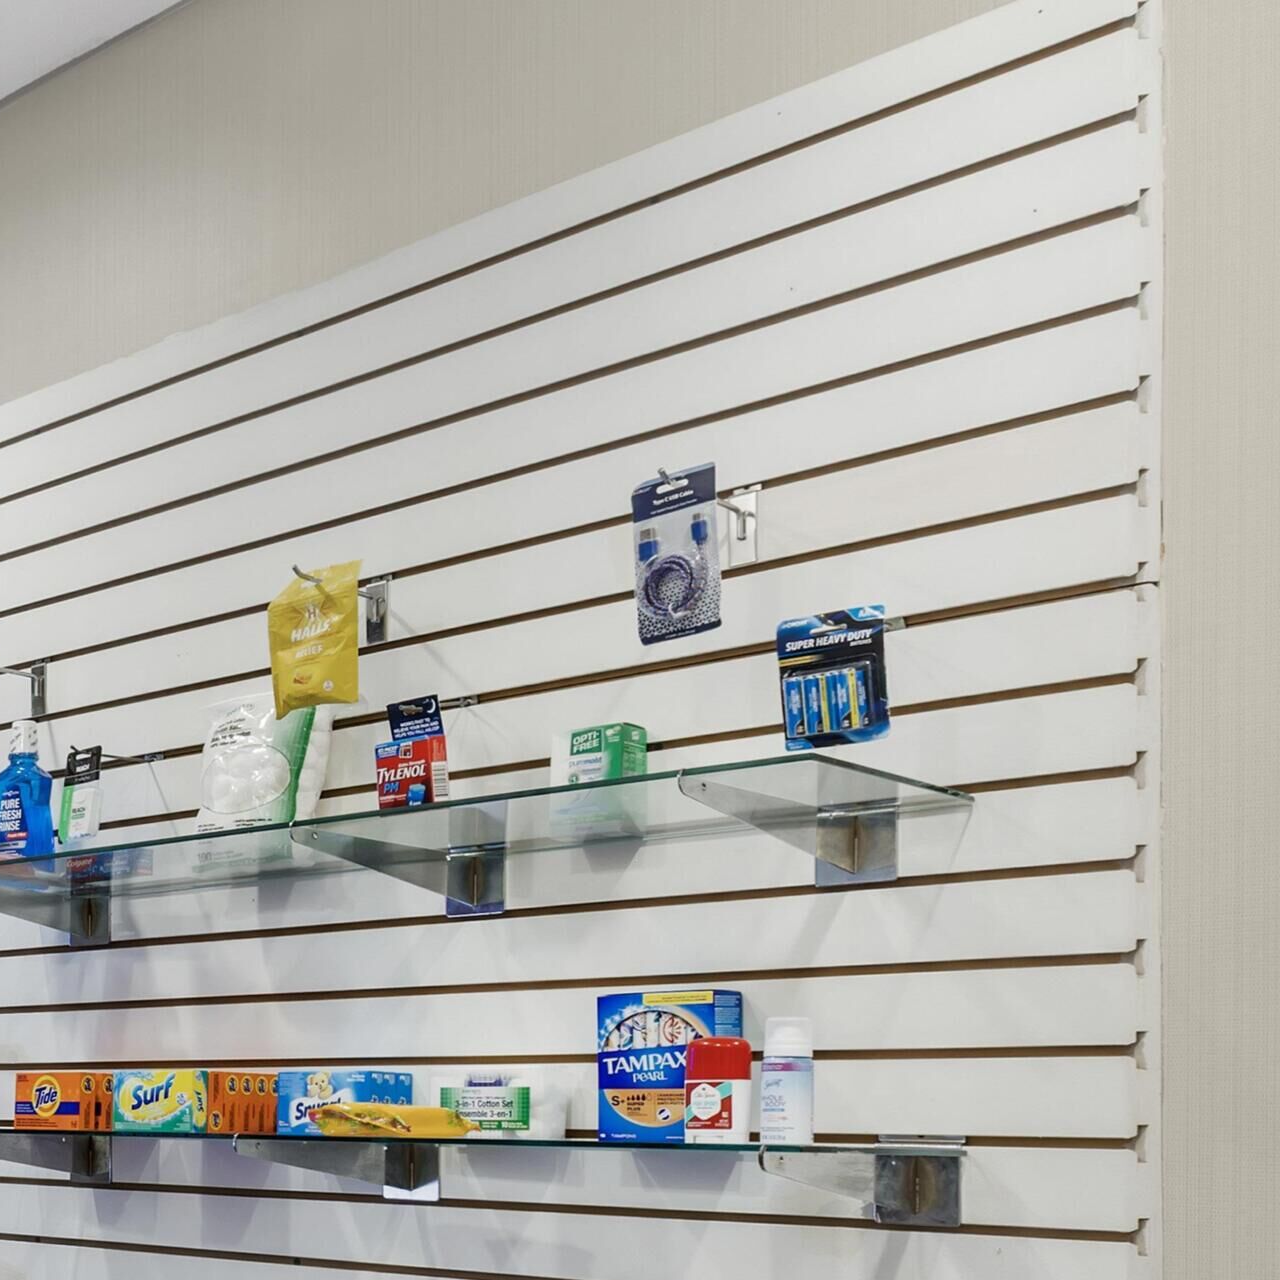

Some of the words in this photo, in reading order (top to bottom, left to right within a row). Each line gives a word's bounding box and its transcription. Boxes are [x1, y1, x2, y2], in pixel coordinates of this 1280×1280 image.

[291, 618, 332, 643] HALLS
[785, 639, 815, 652] SUPER
[815, 634, 847, 647] HEAVY
[847, 628, 873, 640] DUTY
[572, 730, 600, 746] OPTI-
[572, 738, 600, 754] FREE
[377, 763, 428, 785] TYLENOL
[383, 781, 399, 793] PM
[0, 797, 20, 811] PURE
[602, 1050, 687, 1075] TAMPAX
[33, 1083, 58, 1109] Tide
[131, 1072, 177, 1111] Surf
[455, 1100, 476, 1108] 3-in-1
[477, 1099, 501, 1108] Cotton
[501, 1099, 514, 1108] Set
[489, 1110, 513, 1118] 3-en-1
